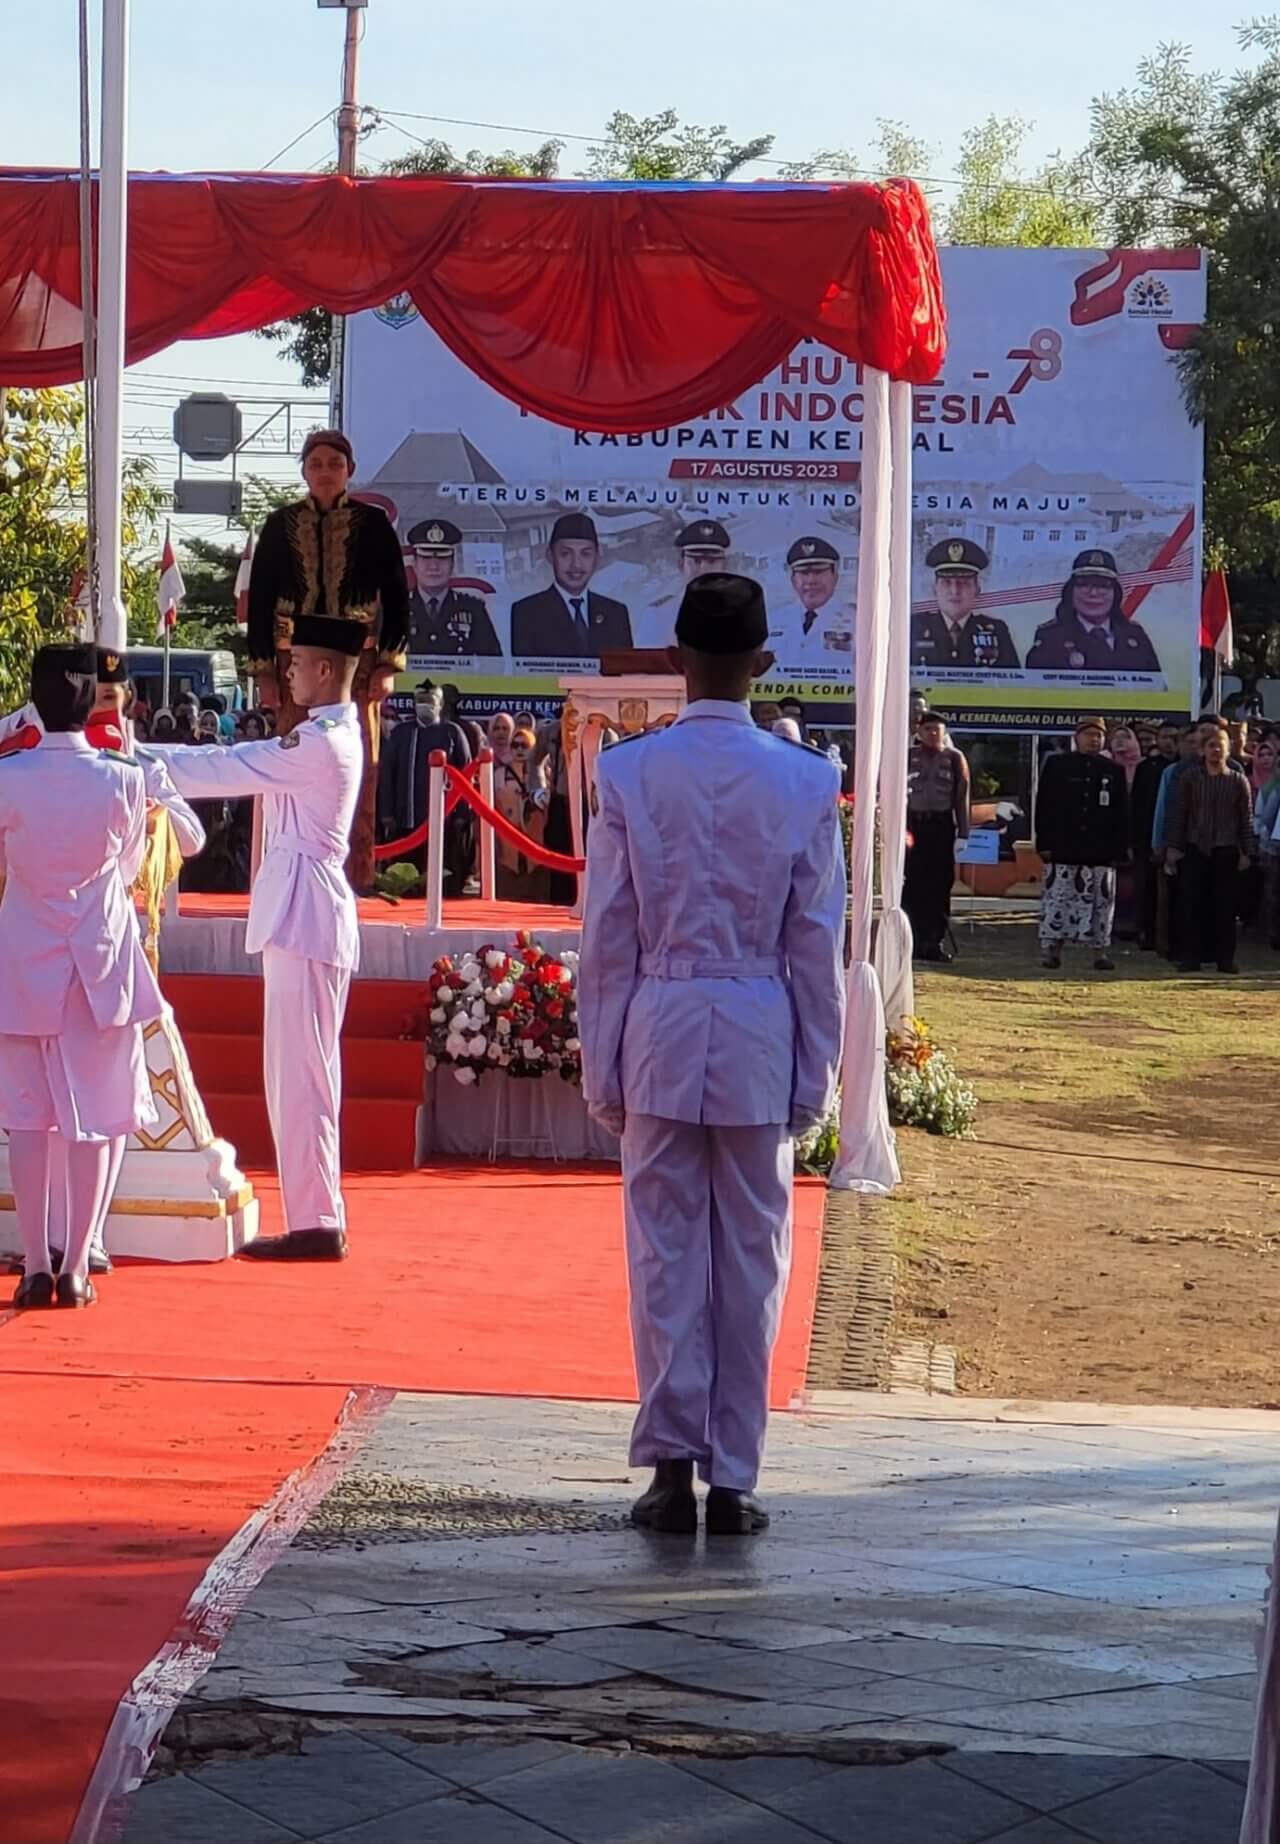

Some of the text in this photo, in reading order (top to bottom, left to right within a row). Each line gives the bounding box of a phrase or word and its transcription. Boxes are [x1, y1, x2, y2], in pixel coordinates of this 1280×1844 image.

[781, 356, 864, 386] HUT
[1006, 328, 1062, 394] 78
[760, 392, 1016, 425] INDOESIA
[574, 428, 954, 452] KABUPATEN KEAL
[691, 462, 838, 478] 17 AGUSTUS 2023
[565, 489, 678, 504] MELAJU
[697, 491, 790, 506] UNTUK
[752, 683, 804, 694] ENDAL
[959, 711, 1040, 724] KEMENANGAN
[1041, 714, 1055, 725] DI
